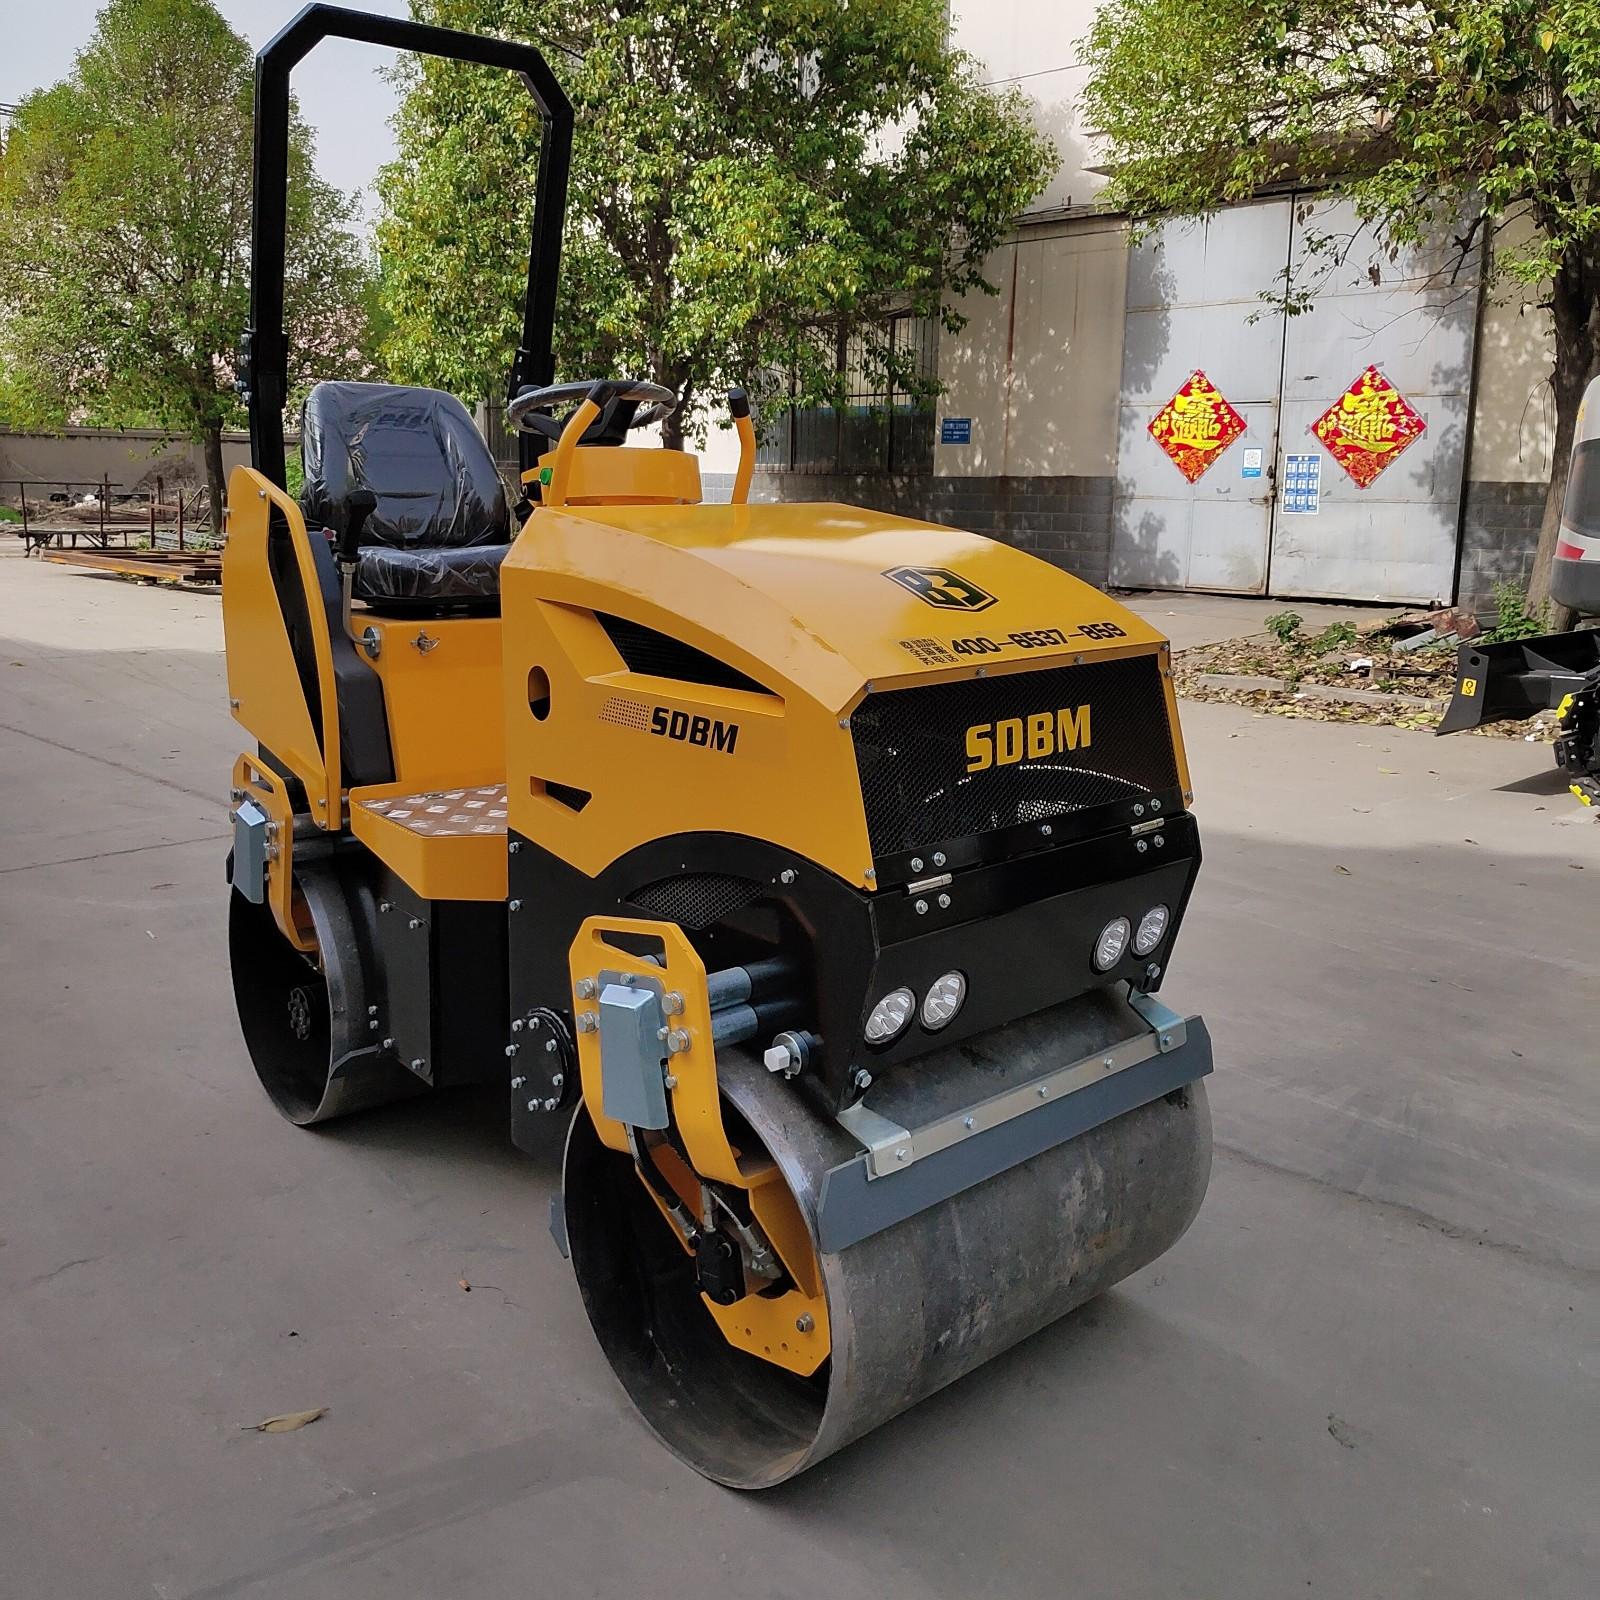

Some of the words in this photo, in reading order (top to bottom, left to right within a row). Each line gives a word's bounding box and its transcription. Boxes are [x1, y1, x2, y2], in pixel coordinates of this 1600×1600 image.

[951, 622, 1127, 656] 400-6537-859
[650, 706, 739, 755] SDBM
[966, 704, 1091, 773] SDBM
